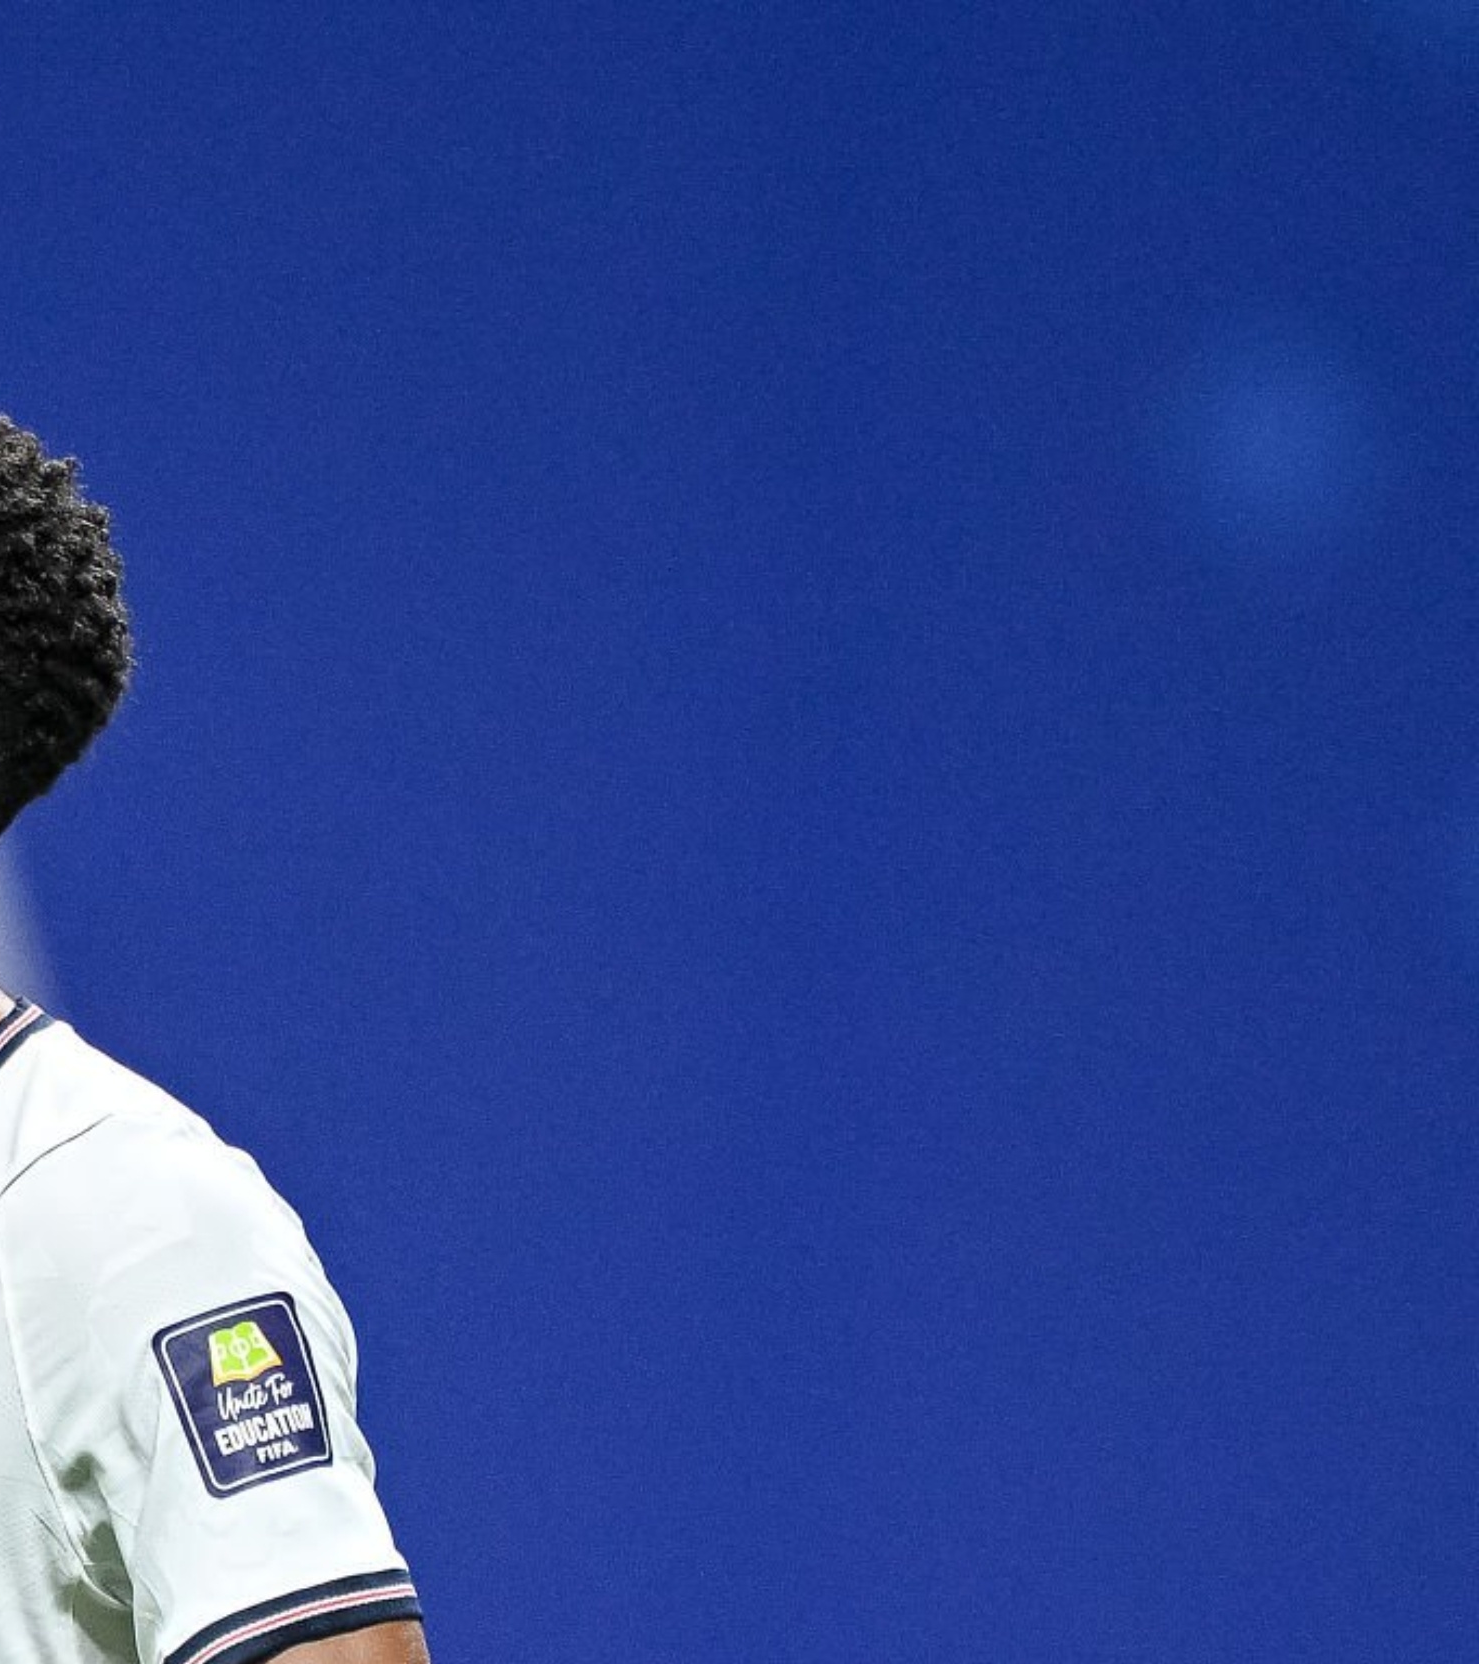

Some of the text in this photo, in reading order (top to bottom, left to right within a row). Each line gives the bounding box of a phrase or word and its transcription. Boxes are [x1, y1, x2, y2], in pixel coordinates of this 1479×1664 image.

[217, 1372, 294, 1422] Unite For
[214, 1403, 314, 1457] EDUCATION
[256, 1439, 297, 1464] FIFA
